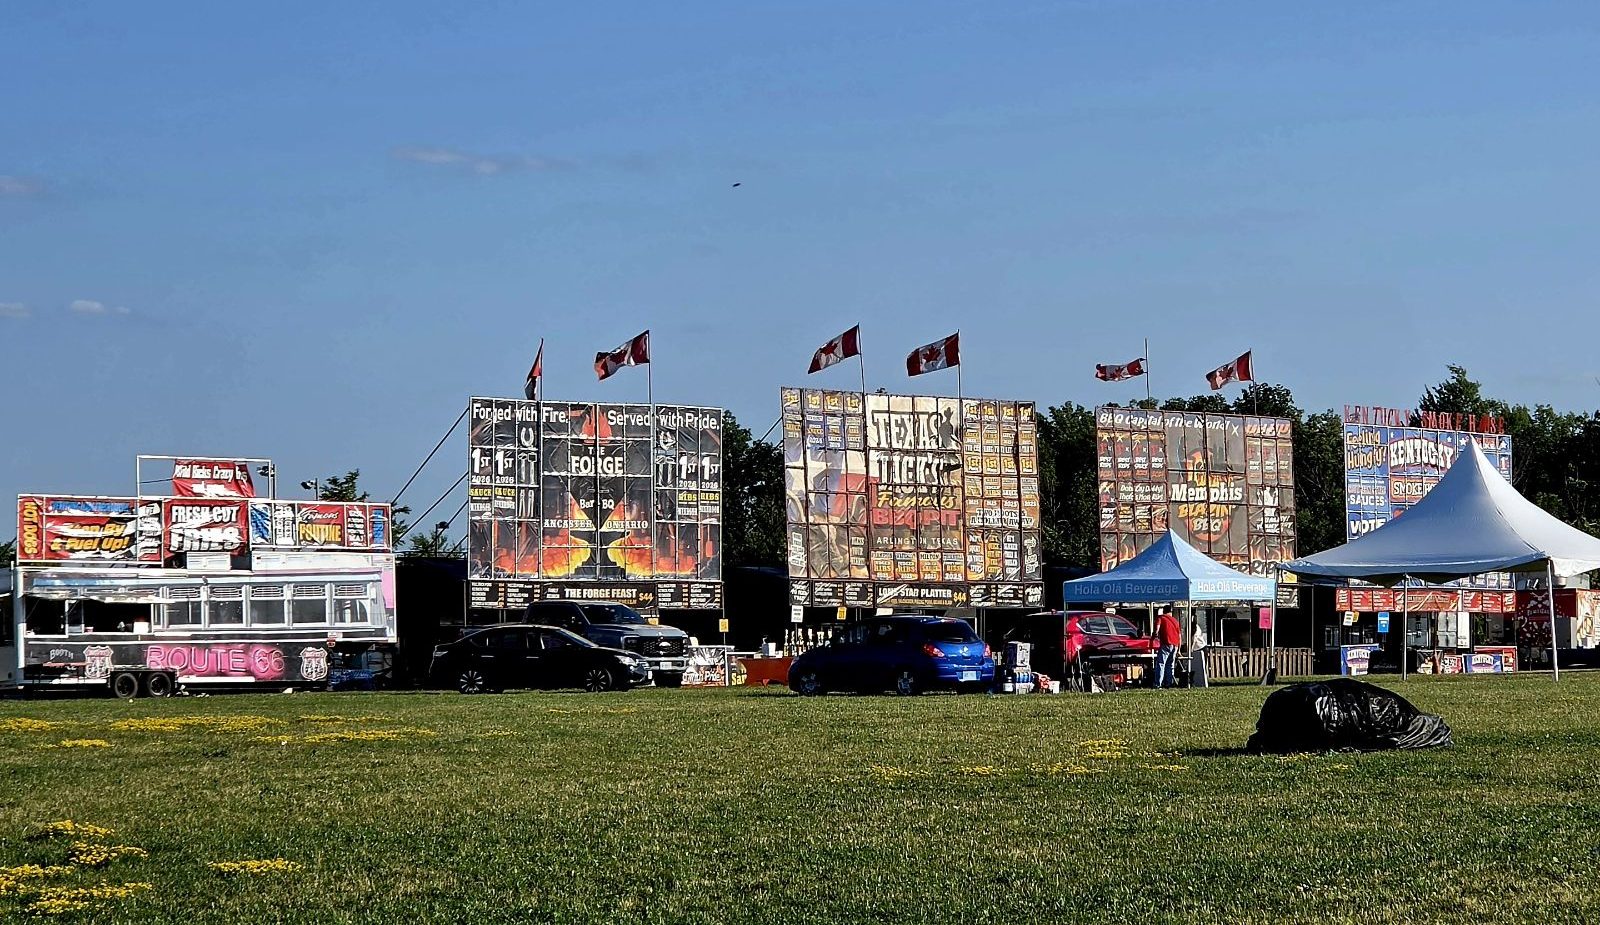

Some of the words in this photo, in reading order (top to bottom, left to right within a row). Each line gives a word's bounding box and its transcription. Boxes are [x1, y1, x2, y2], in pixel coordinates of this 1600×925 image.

[472, 403, 512, 424] Forged
[514, 405, 538, 422] with
[608, 410, 652, 426] Served
[660, 412, 684, 428] with
[1100, 413, 1123, 424] BBQ
[872, 411, 944, 449] TEXAS
[1390, 438, 1450, 470] KENTUCKY
[571, 455, 624, 476] FORGE
[877, 492, 957, 509] Famous
[1171, 482, 1243, 502] Memphis
[1350, 494, 1385, 506] SAUCES
[25, 501, 38, 524] HOT
[25, 501, 38, 524] HOT
[580, 499, 595, 509] Bar
[298, 523, 342, 542] POUTINE
[543, 519, 593, 529] ANCASTER
[607, 520, 649, 529] ONTARIO
[25, 526, 39, 555] DOGS
[65, 538, 99, 552] Fuel
[101, 537, 129, 554] Up!
[565, 589, 585, 598] THE
[586, 589, 611, 598] FORGE
[612, 589, 637, 598] FEAST
[920, 588, 952, 598] PLATTER
[953, 591, 967, 603] $44
[1075, 583, 1099, 595] Hola
[1126, 583, 1178, 598] Beverage
[1197, 582, 1215, 591] Hola
[1232, 582, 1268, 593] Beverage
[147, 646, 248, 672] ROUTE
[252, 650, 286, 672] 66
